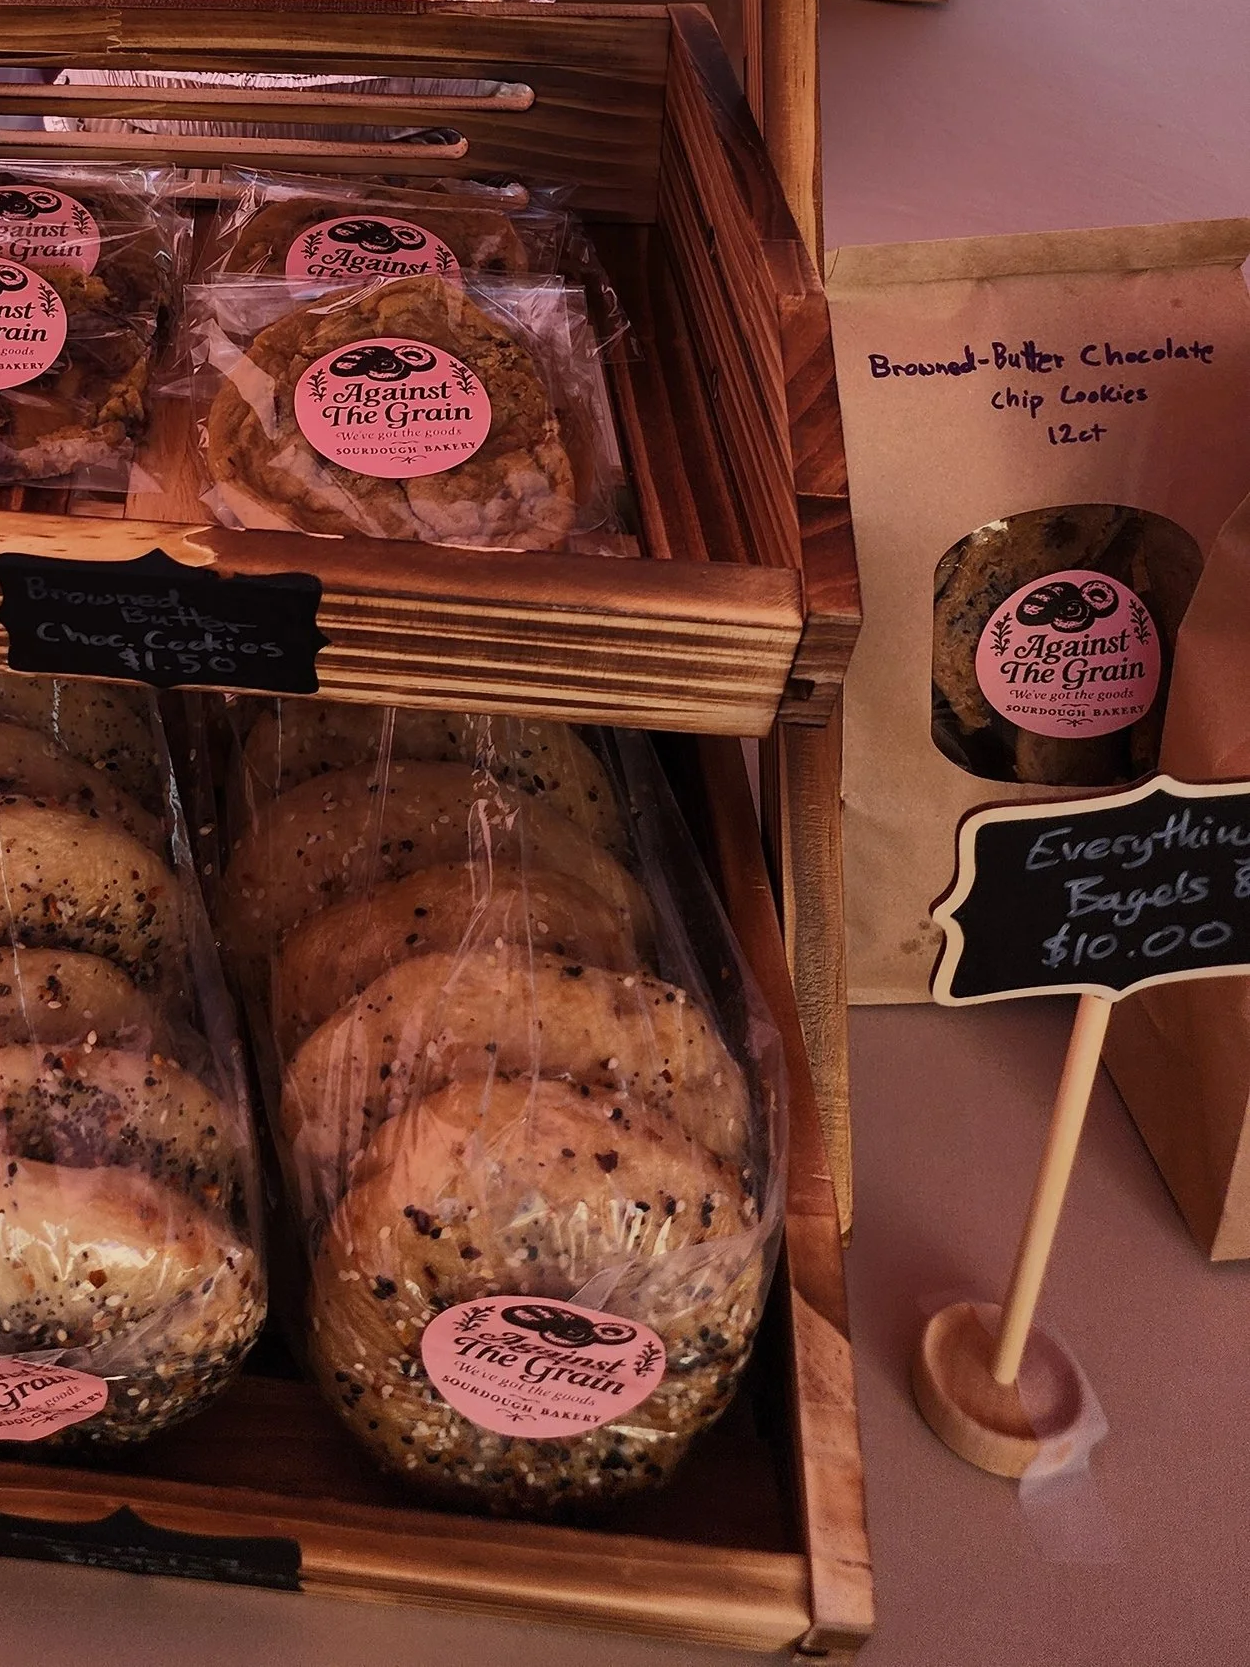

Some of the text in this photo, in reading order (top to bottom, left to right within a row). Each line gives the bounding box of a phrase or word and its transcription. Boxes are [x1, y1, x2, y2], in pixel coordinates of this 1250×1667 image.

[9, 239, 84, 262] Grain
[321, 248, 432, 275] Against
[1, 345, 35, 357] goods
[1080, 337, 1215, 368] Chocolate
[333, 380, 452, 409] Against
[1060, 384, 1149, 406] Cookies
[322, 402, 474, 430] The Grain
[378, 430, 400, 441] got
[401, 427, 422, 439] the
[424, 426, 463, 438] goods
[336, 440, 477, 456] SOURDOUGH BAKERY
[25, 576, 182, 609] Browned
[121, 606, 258, 634] Butter
[1013, 628, 1132, 664] Against
[117, 649, 238, 675] $1.50
[1000, 657, 1146, 691] The Grain
[1009, 688, 1135, 702] We've got the goods
[1005, 704, 1145, 718] SOURDOUGH BAKERY
[1024, 808, 1250, 871] Everythin
[1064, 870, 1210, 926] Bagels
[1041, 921, 1233, 969] $10.00
[453, 1336, 626, 1397] The Grain
[478, 1331, 628, 1374] Against
[441, 1373, 602, 1424] SOURDOUGH BAKERY
[499, 1377, 527, 1394] got
[529, 1381, 552, 1398] the
